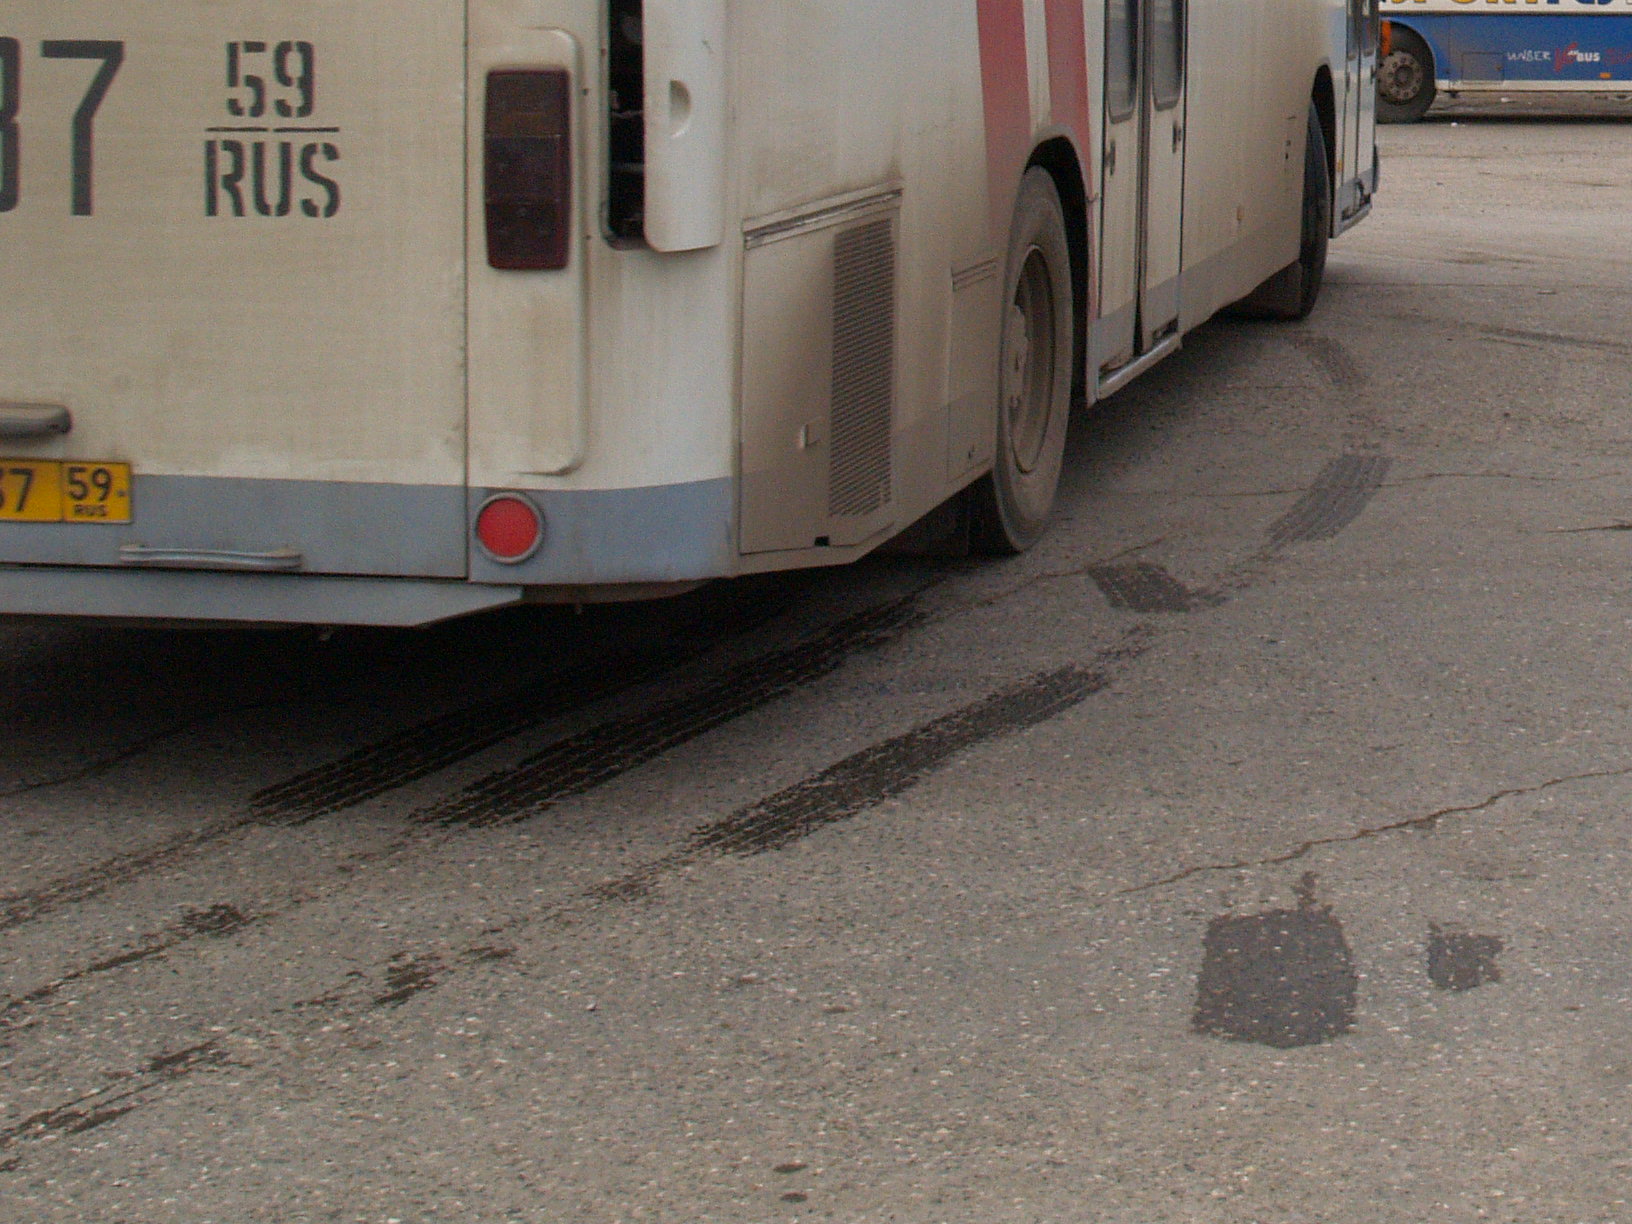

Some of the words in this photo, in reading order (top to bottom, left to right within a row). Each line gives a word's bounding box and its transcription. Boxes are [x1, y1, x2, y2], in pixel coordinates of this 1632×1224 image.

[226, 40, 314, 118] 59
[205, 139, 340, 219] RUS
[68, 466, 112, 501] 59
[74, 504, 107, 517] RUS
